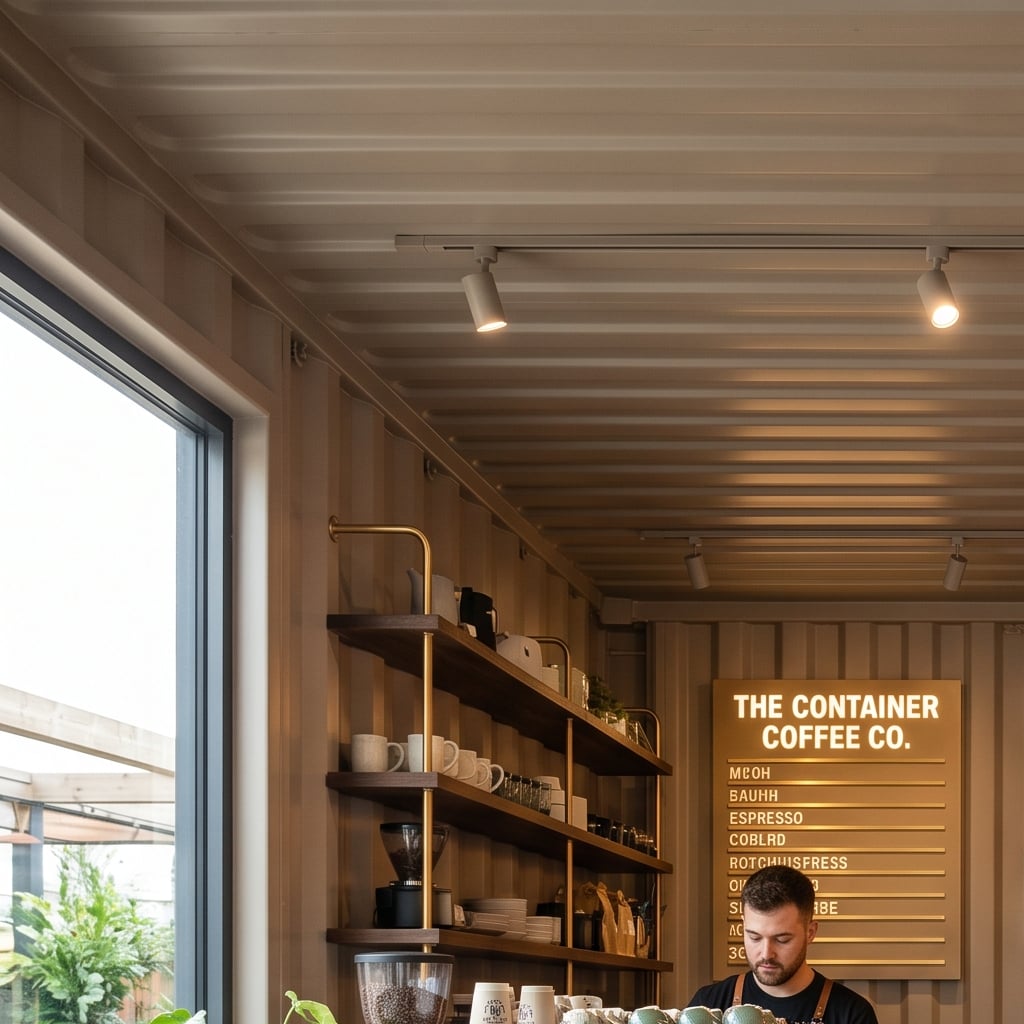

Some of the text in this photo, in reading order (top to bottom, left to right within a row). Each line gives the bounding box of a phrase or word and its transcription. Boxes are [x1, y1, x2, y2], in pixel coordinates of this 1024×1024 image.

[733, 694, 939, 719] THE CONTAINER
[762, 725, 911, 749] COFFEE CO.
[729, 811, 803, 825] ESPRESSO
